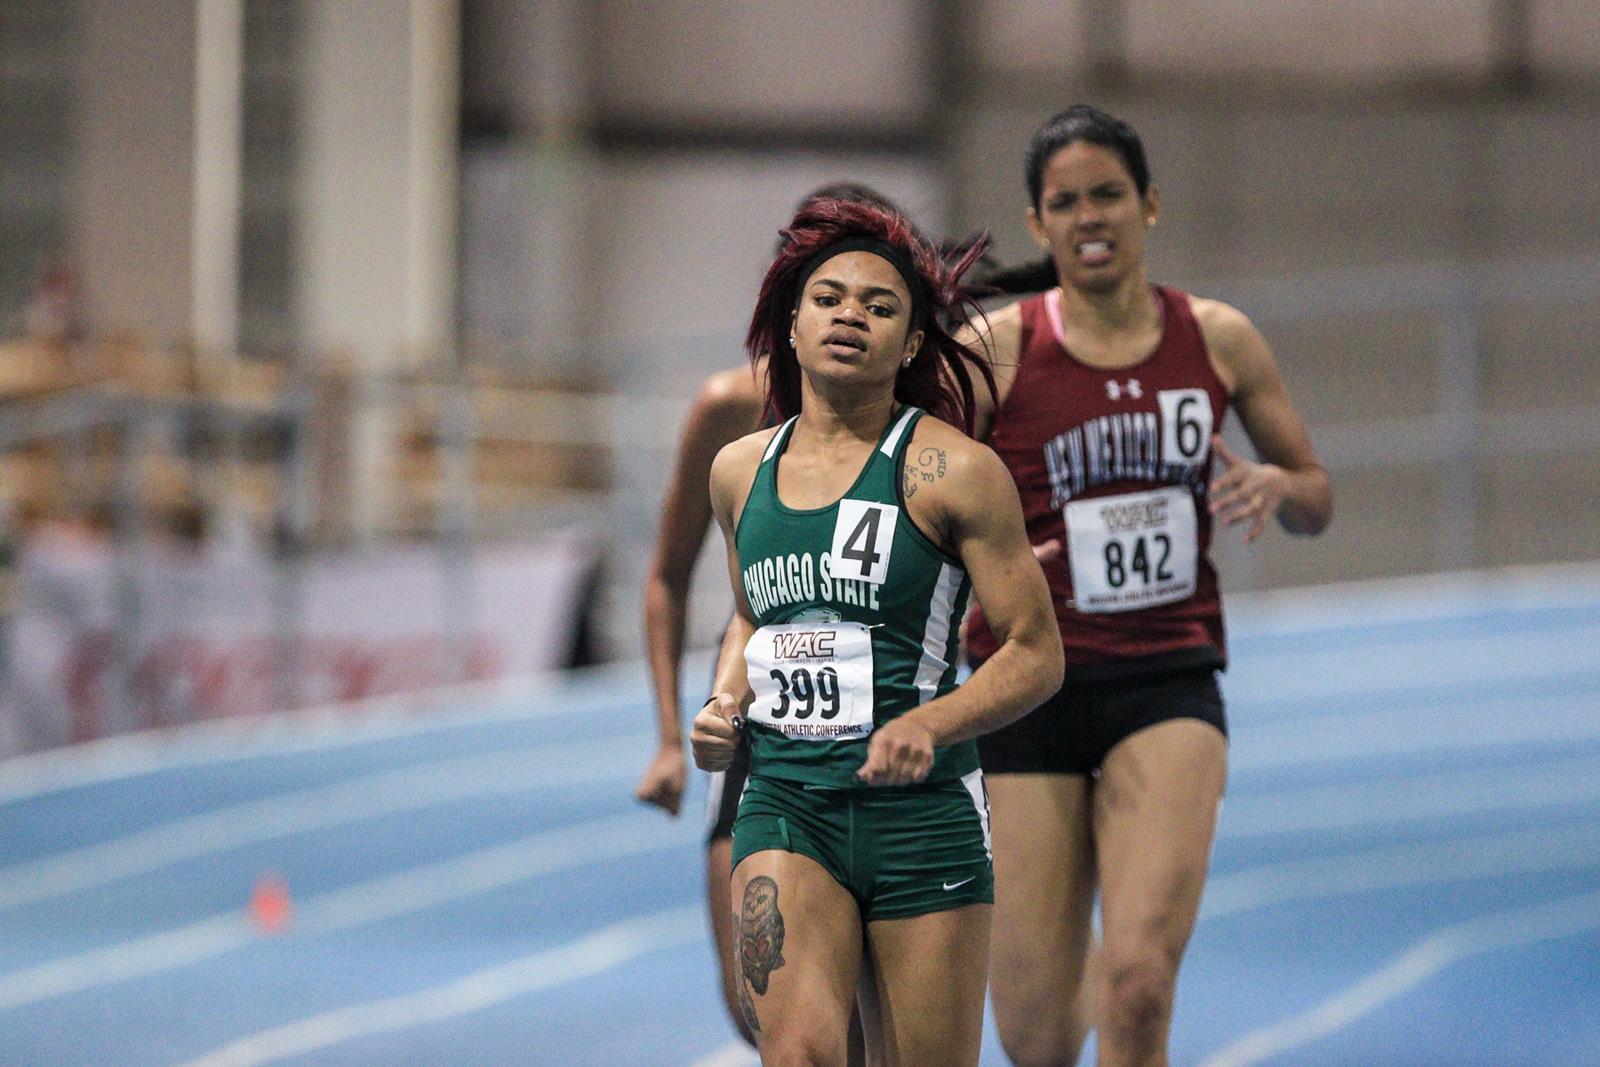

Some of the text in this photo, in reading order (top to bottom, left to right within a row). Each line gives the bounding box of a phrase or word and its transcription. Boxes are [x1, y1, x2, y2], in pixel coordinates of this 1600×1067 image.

[1176, 397, 1201, 457] 6
[841, 507, 882, 577] 4
[1105, 533, 1173, 587] 842
[744, 552, 815, 618] CHICAGO
[772, 631, 836, 659] WAC
[770, 667, 840, 719] 399
[783, 723, 815, 736] ATHLETIC
[816, 724, 863, 736] CONFERENCE
